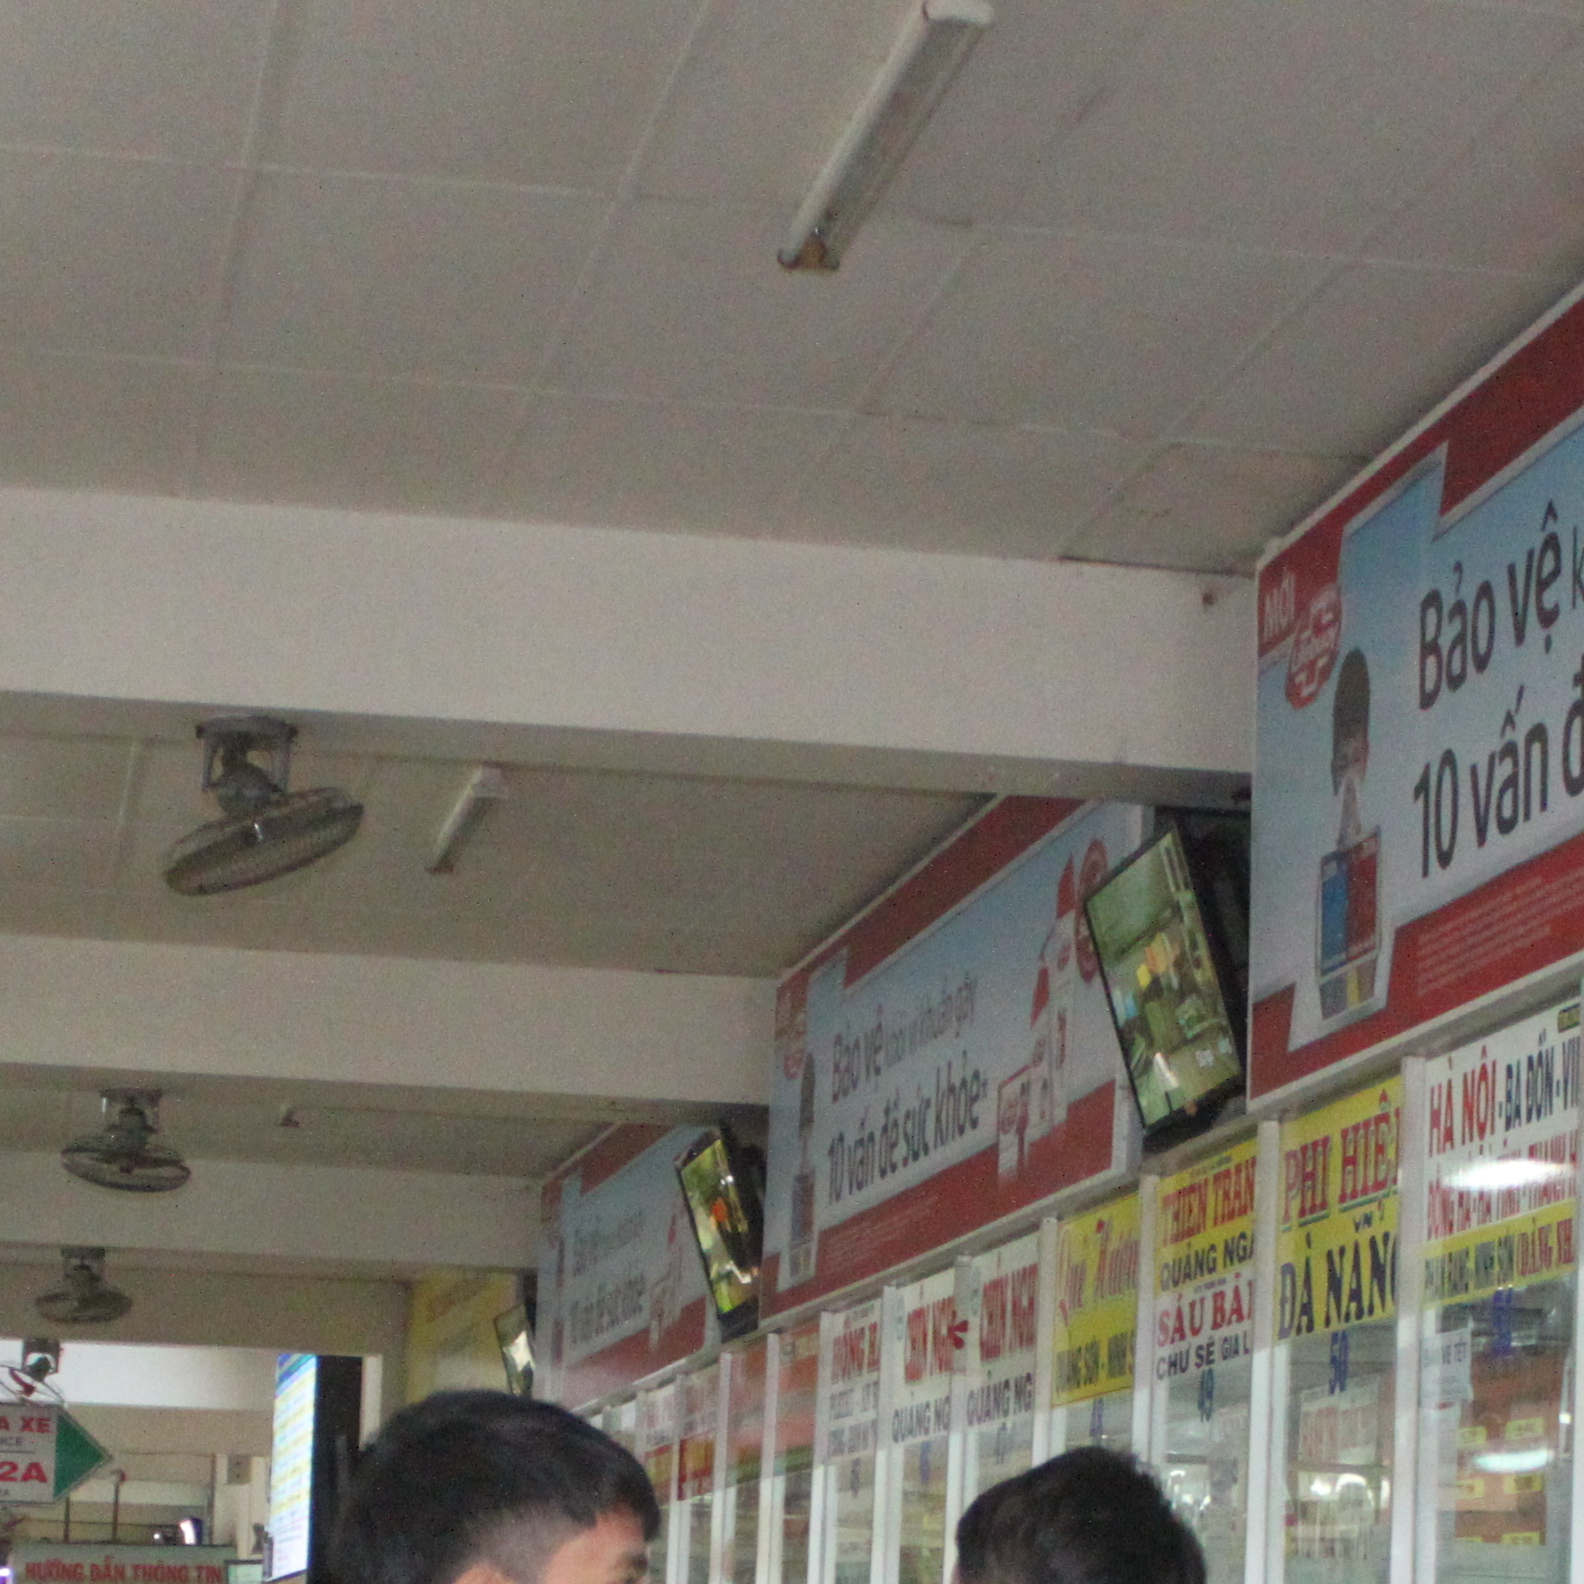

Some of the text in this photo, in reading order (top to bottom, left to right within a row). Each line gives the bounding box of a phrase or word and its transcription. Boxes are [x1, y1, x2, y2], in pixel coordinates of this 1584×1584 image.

[1417, 561, 1496, 711] Bảo
[1507, 500, 1563, 648] vệ
[1414, 748, 1460, 879] 10
[1470, 685, 1548, 848] vấn
[1428, 1054, 1454, 1158] HÀ
[1461, 1044, 1497, 1156] NỘI
[1282, 1134, 1331, 1226] PHI
[1160, 1241, 1217, 1291] QUẢNG
[1278, 1232, 1314, 1340] ĐÀ
[1158, 1291, 1205, 1347] SÁU
[20, 1416, 52, 1434] XE
[133, 1558, 190, 1584] THÔNG
[196, 1565, 223, 1584] TIN
